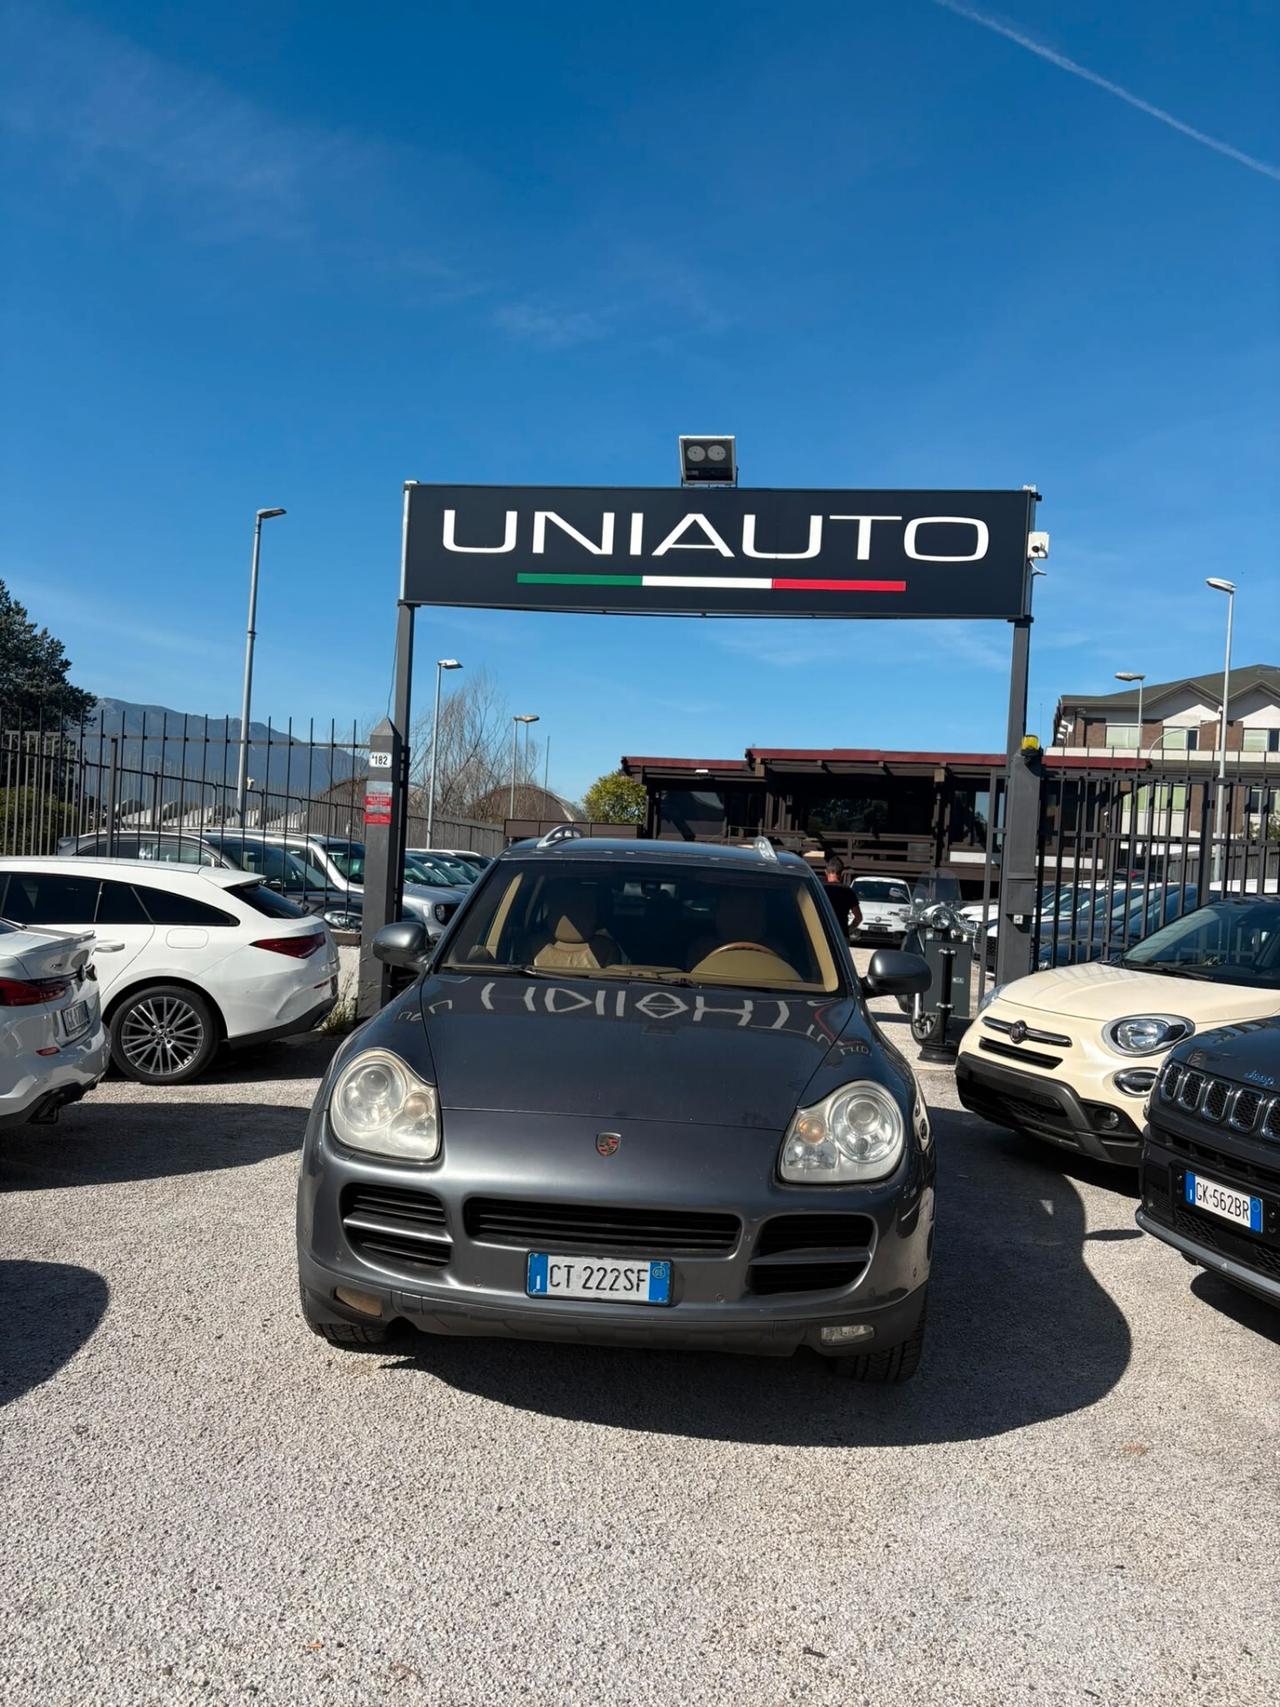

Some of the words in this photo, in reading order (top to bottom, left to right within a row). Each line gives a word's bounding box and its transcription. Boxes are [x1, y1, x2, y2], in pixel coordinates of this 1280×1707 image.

[442, 509, 990, 562] UNIAUTO
[549, 1265, 574, 1288] CT
[581, 1265, 649, 1293] 222SF
